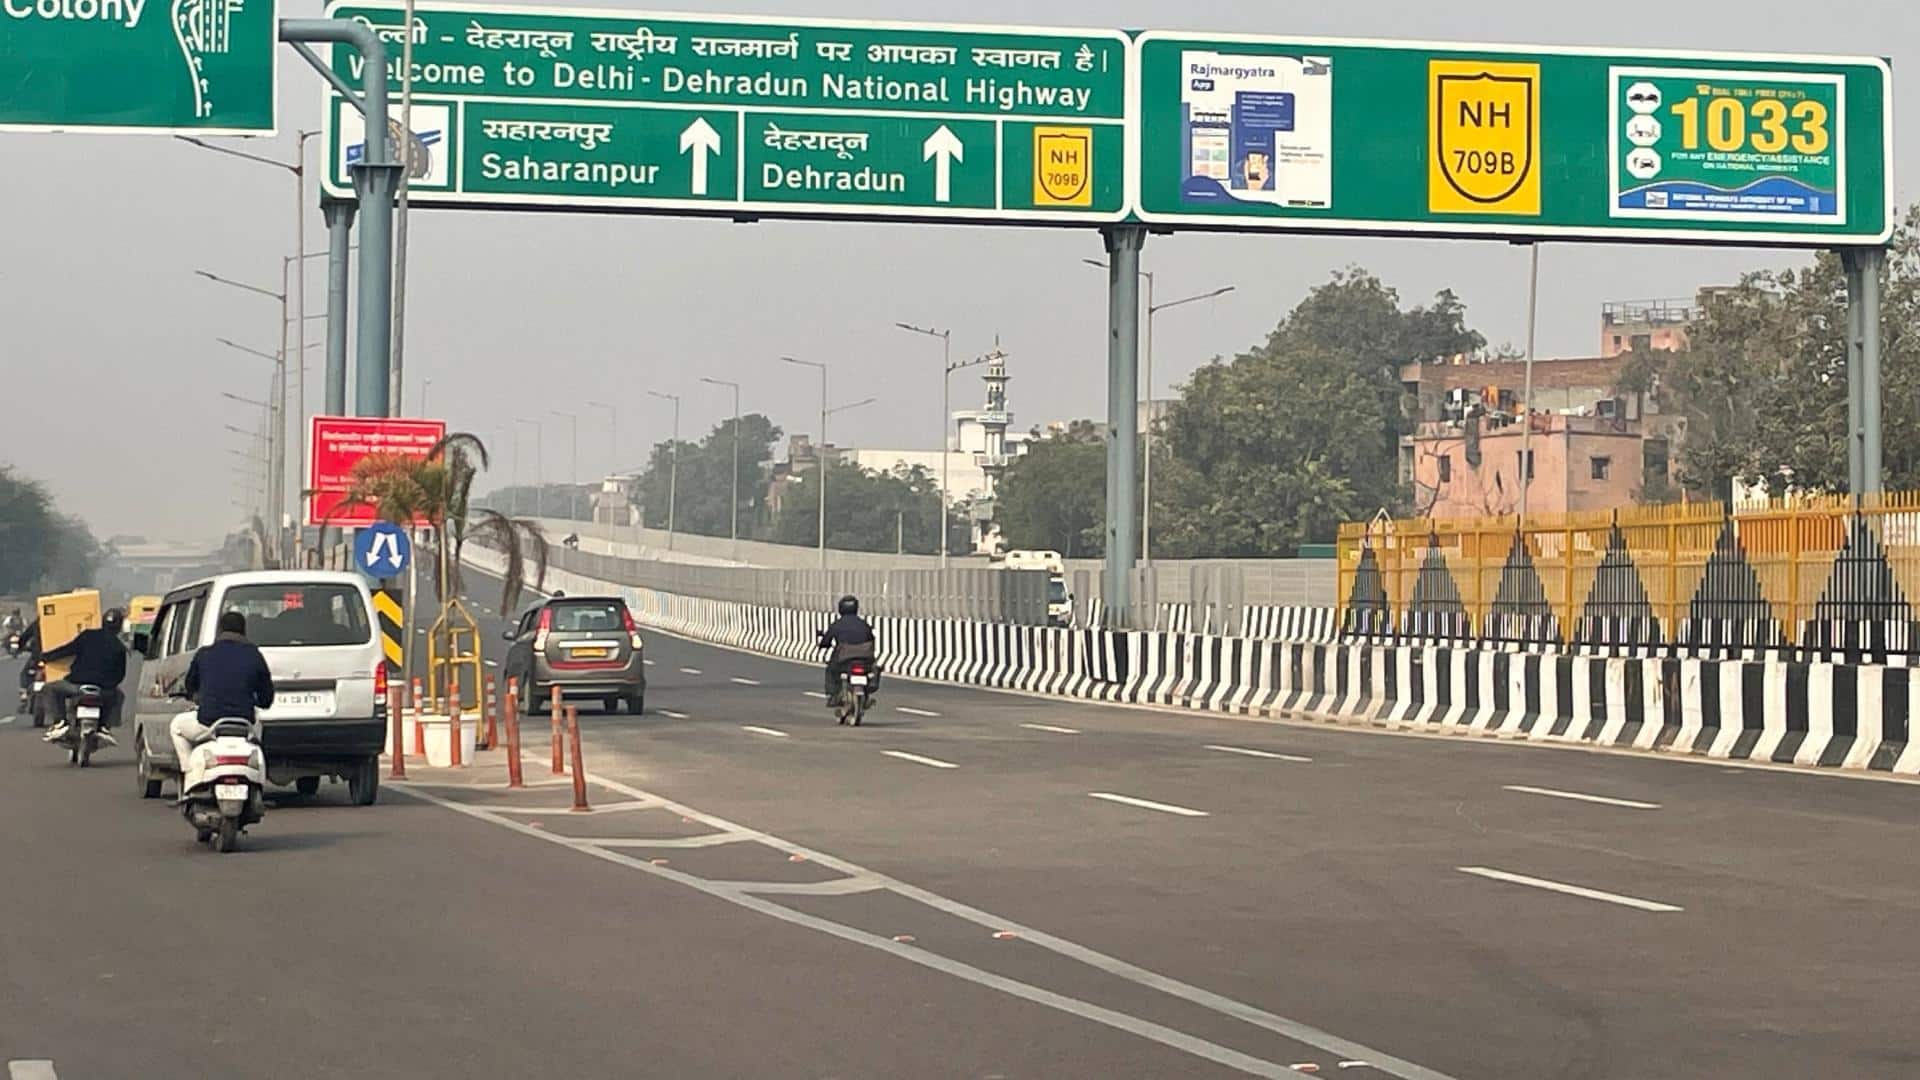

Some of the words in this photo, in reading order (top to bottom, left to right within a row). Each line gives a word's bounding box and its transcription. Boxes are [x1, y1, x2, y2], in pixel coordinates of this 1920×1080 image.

[466, 20, 575, 58] देहरादून
[590, 28, 678, 62] राष्ट्रीय
[691, 33, 799, 60] राजमार्ग
[815, 42, 853, 62] पर
[866, 45, 957, 66] आपका
[971, 48, 1061, 70] स्वागत
[1190, 63, 1275, 80] Rajmargyatra
[503, 62, 534, 86] to
[554, 62, 634, 91] Delhi
[663, 67, 807, 97] Dehradun
[823, 74, 949, 102] National
[966, 79, 1091, 111] Highway
[1460, 101, 1510, 128] NH
[1671, 97, 1829, 155] 1033
[482, 120, 613, 150] सहारनपुर
[763, 122, 869, 159] देहरादून
[482, 153, 659, 187] Saharanpur
[1050, 150, 1078, 164] NH
[1452, 149, 1515, 177] 709B
[763, 163, 905, 192] Dehradun
[1047, 173, 1079, 187] 709B
